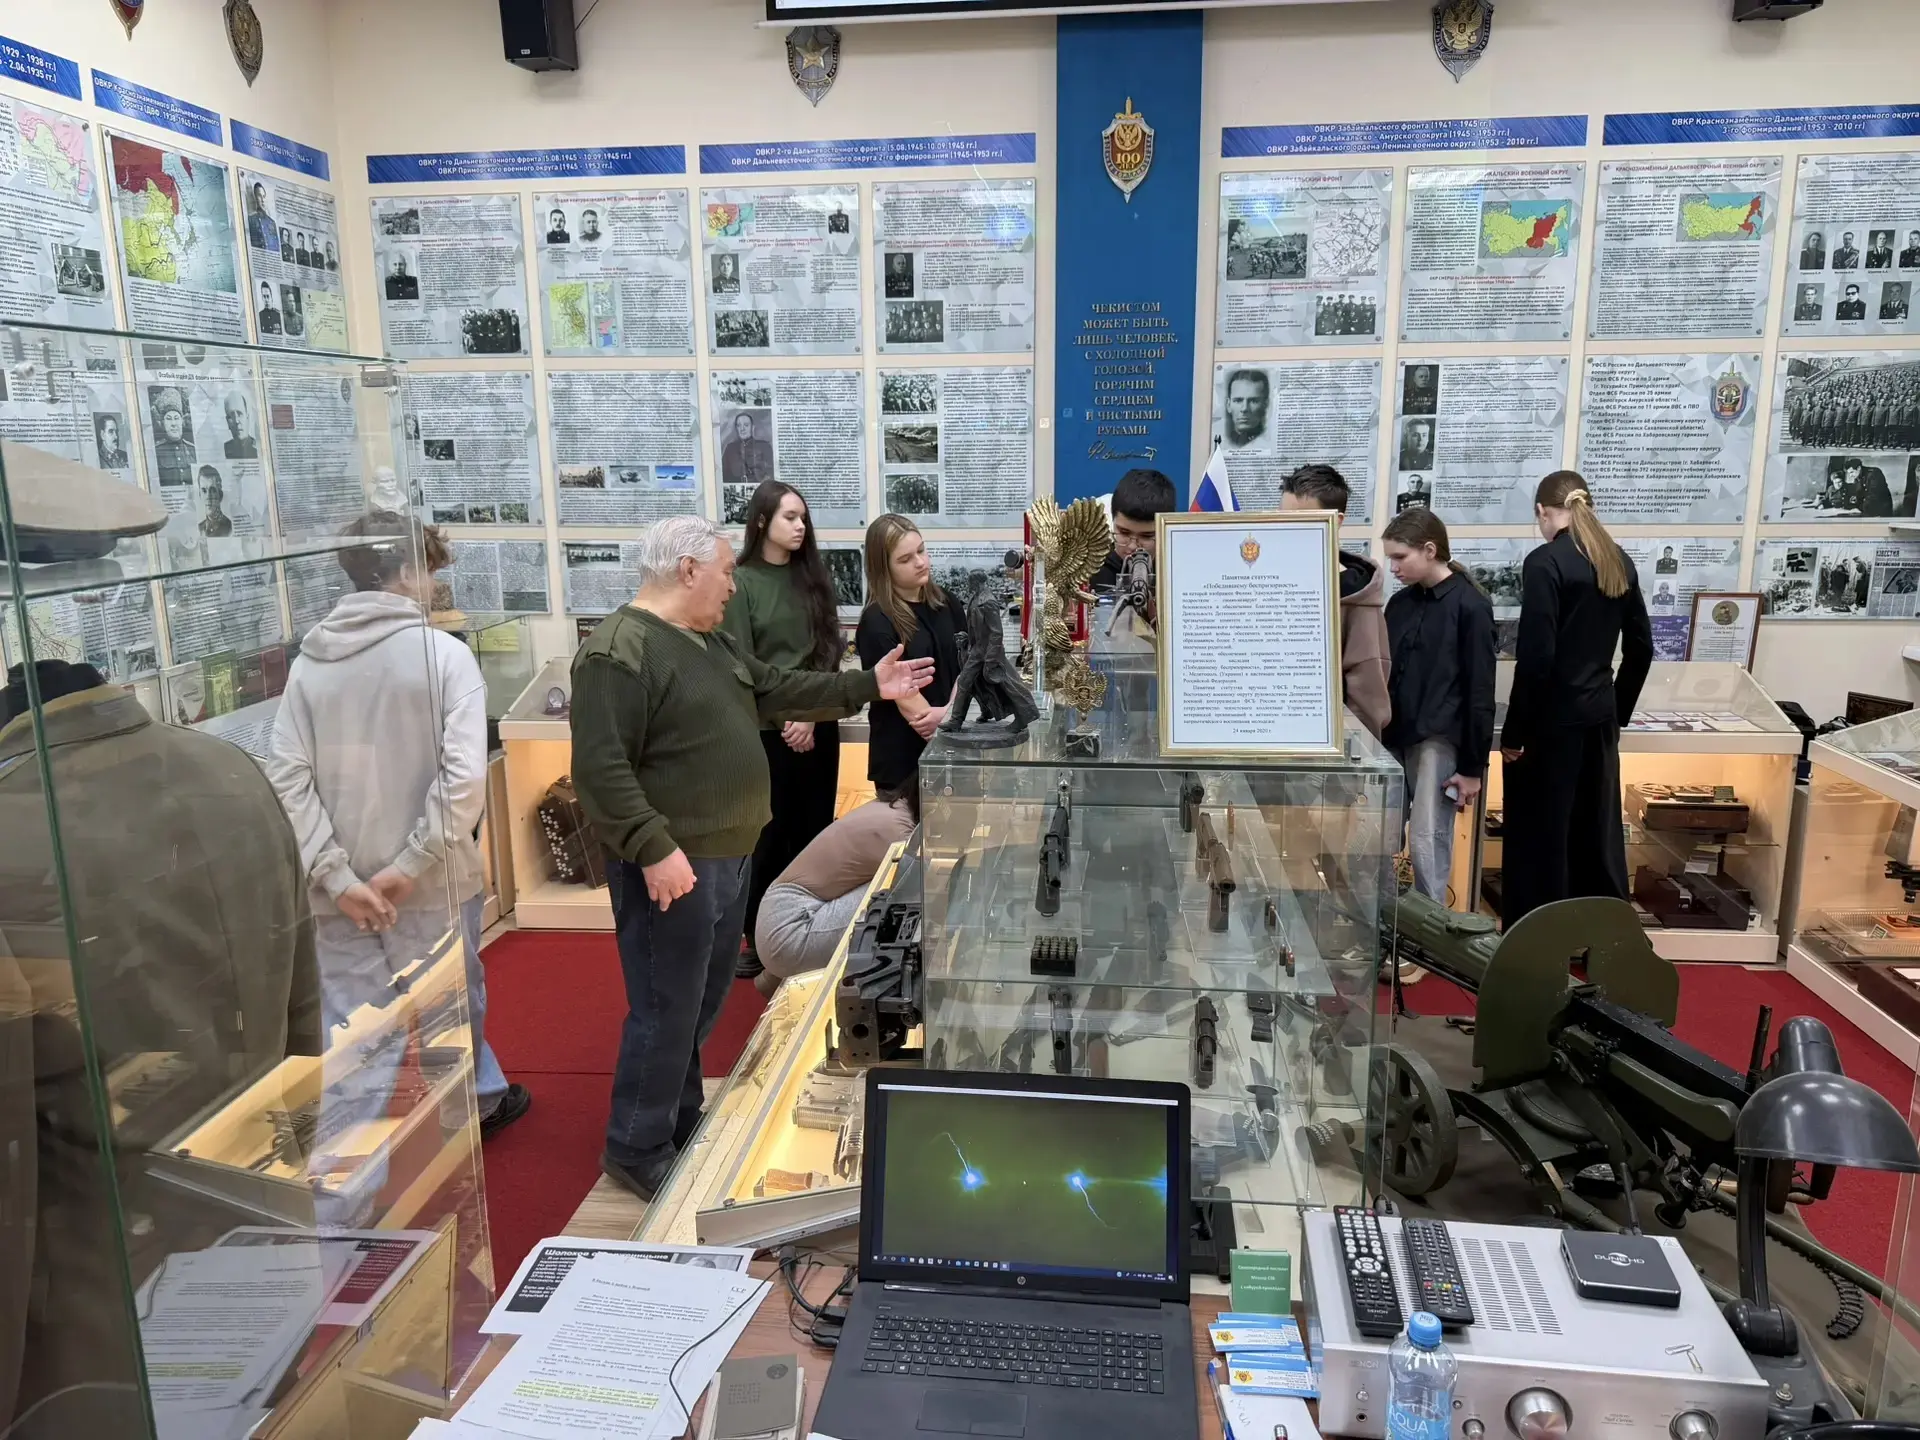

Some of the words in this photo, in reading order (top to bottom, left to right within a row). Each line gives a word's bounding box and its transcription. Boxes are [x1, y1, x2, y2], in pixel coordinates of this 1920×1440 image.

[1, 44, 20, 58] 1929
[26, 53, 44, 67] 1938
[8, 59, 45, 79] 2.06.1935
[94, 77, 113, 89] ОВКР
[1671, 117, 1694, 126] ОВКР
[1773, 113, 1850, 124] Дальневосточного
[1851, 112, 1890, 120] военного
[1891, 111, 1920, 120] округа
[1314, 125, 1336, 133] ОВКР
[1338, 123, 1400, 132] Забайкальского
[1400, 122, 1429, 131] фронта
[1460, 120, 1478, 128] 1945
[1722, 126, 1739, 134] 3-го
[1740, 125, 1801, 135] формирования
[1833, 122, 1853, 131] 2010
[1295, 135, 1317, 143] ОВКР
[1319, 134, 1372, 143] Забайкальско
[1379, 131, 1419, 141] Амурского
[1422, 131, 1448, 140] округа
[1478, 128, 1496, 137] 1953
[755, 148, 774, 156] ОВКР
[793, 146, 859, 156] Дальневосточного
[859, 145, 886, 153] фронта
[1266, 145, 1289, 153] ОВКР
[1289, 144, 1350, 153] Забайкальского
[1351, 143, 1380, 152] ордена
[1381, 141, 1411, 150] Ленина
[1412, 140, 1449, 149] военного
[1450, 140, 1476, 148] округа
[1506, 137, 1525, 146] 2010
[453, 157, 516, 167] Дальневосточного
[517, 156, 542, 164] фронта
[583, 152, 620, 161] 10.09.1945
[731, 157, 751, 166] ОВКР
[752, 156, 818, 166] Дальневосточного
[852, 155, 877, 163] округа
[895, 152, 949, 162] формирования
[1116, 152, 1141, 164] 100
[438, 167, 457, 175] ОВКР
[458, 167, 501, 176] Приморского
[536, 165, 559, 173] округа
[1091, 302, 1161, 313] ЧЕКИСТОМ
[1082, 318, 1129, 329] МОЖЕТ
[1132, 317, 1169, 328] БЫТЬ
[1072, 334, 1113, 345] ЛИШЬ
[1116, 332, 1178, 344] ЧЕЛОВЕК,
[1084, 350, 1092, 360] С
[1095, 346, 1165, 360] ХОЛОДНОЙ
[1094, 379, 1154, 390] ГОРЯЧИМ
[1094, 395, 1153, 406] СЕРДЦЕМ
[1085, 411, 1094, 421] И
[1097, 410, 1162, 420] ЧИСТЫМИ
[1388, 1404, 1429, 1435] AQUA
